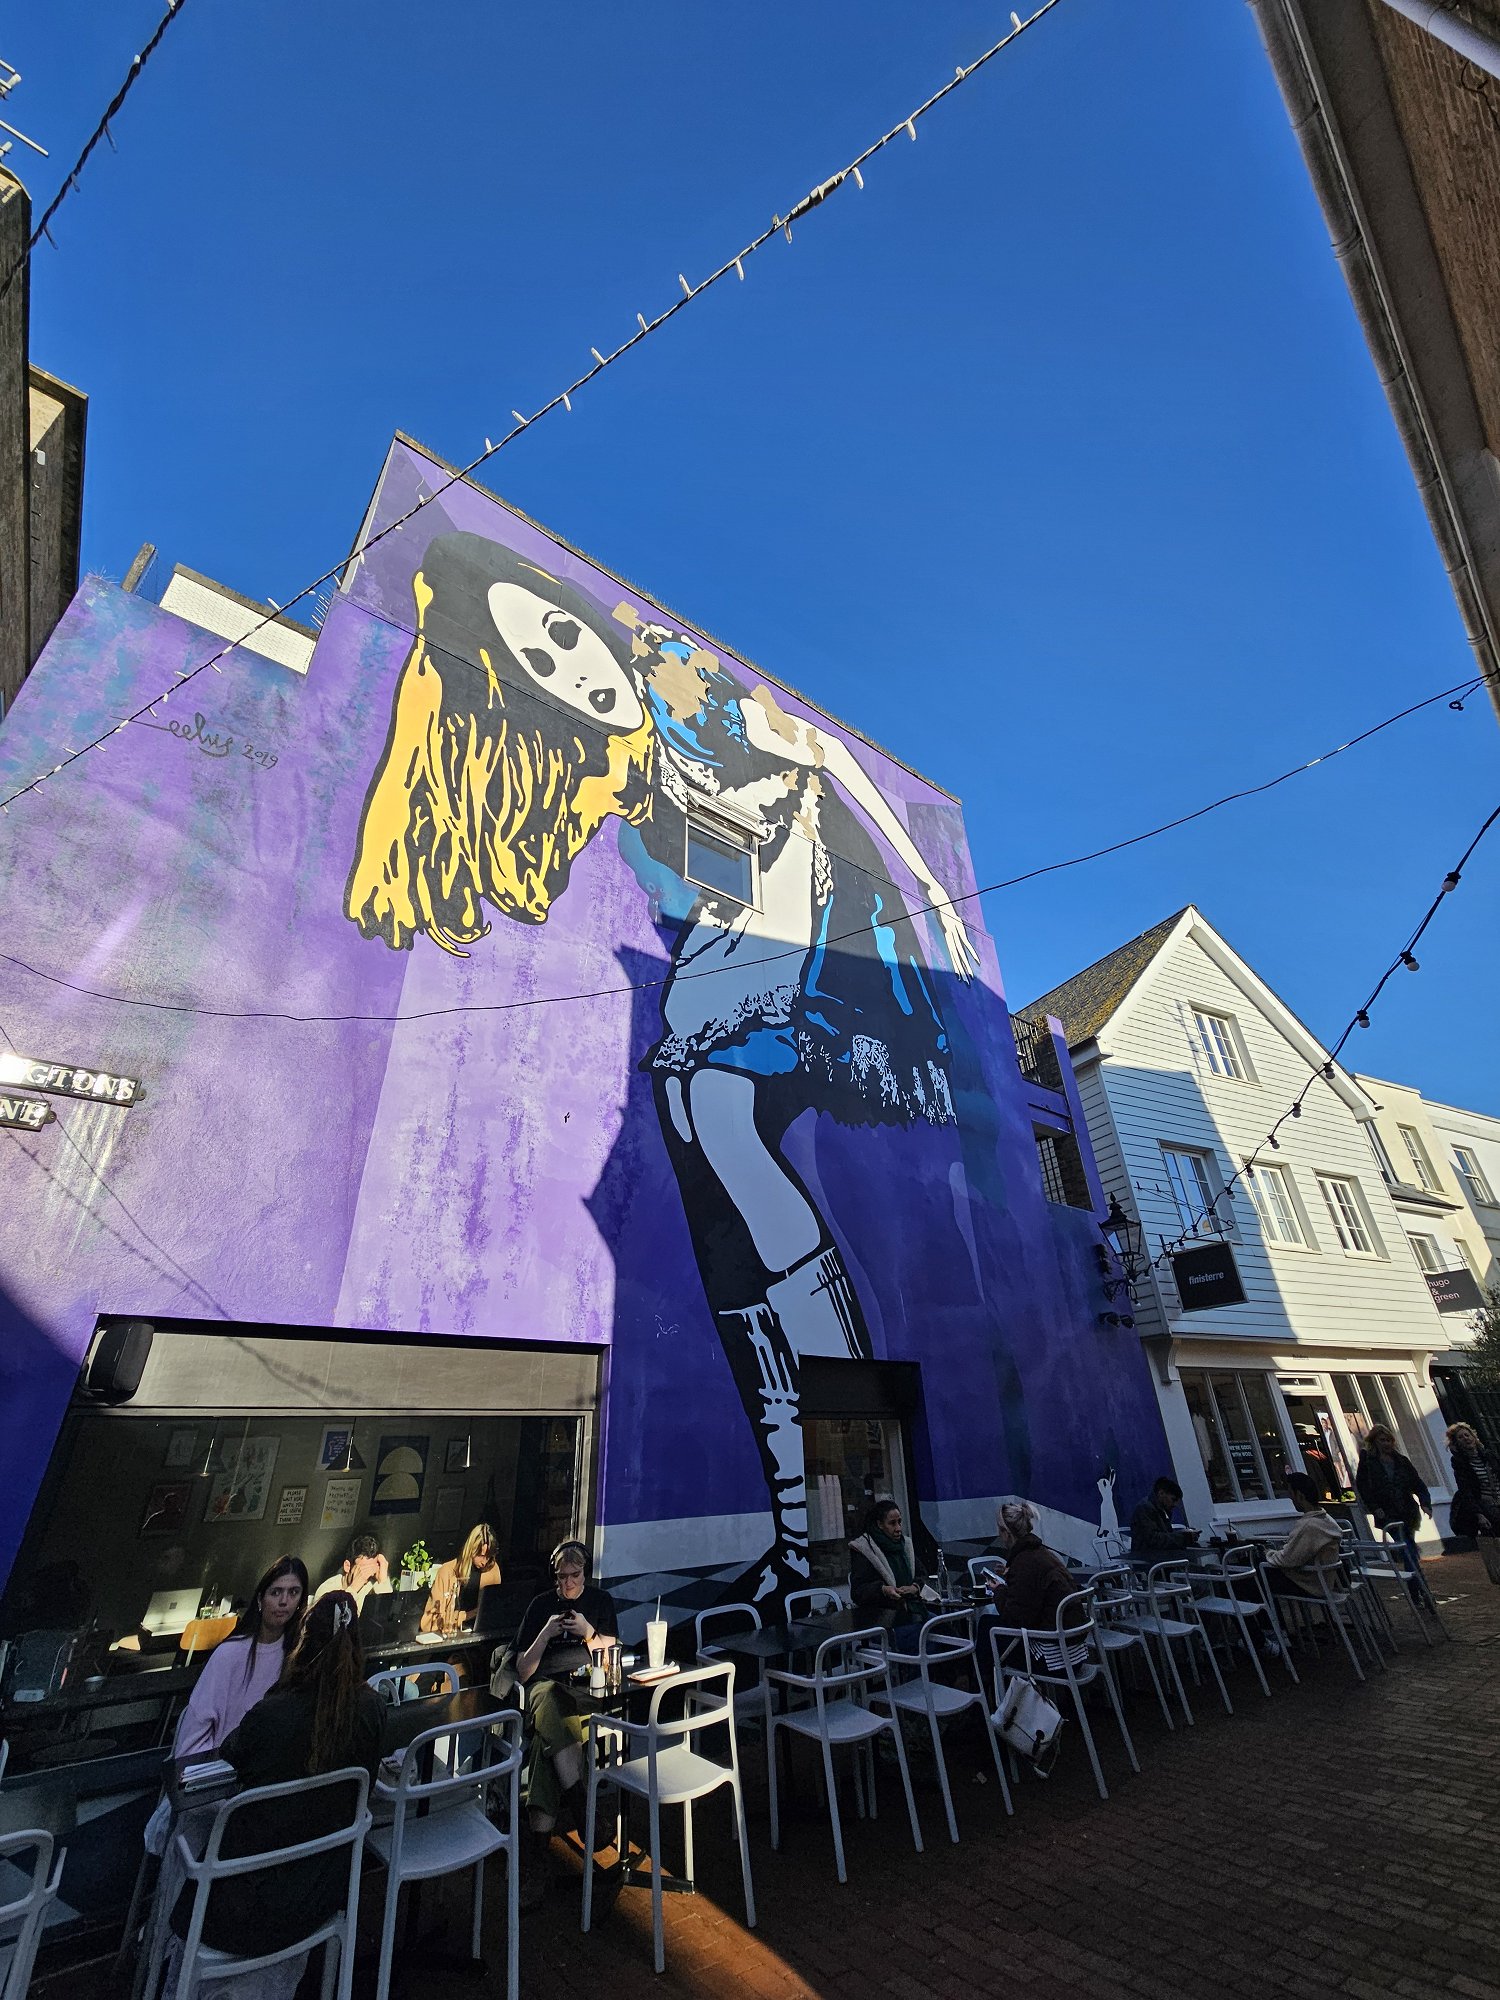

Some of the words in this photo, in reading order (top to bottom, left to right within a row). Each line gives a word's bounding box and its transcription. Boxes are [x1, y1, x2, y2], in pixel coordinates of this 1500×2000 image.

[241, 744, 279, 770] 2019
[25, 1063, 136, 1100] GTONS
[1189, 1271, 1225, 1285] finisterre
[1427, 1279, 1450, 1288] hugo
[1434, 1292, 1460, 1303] green
